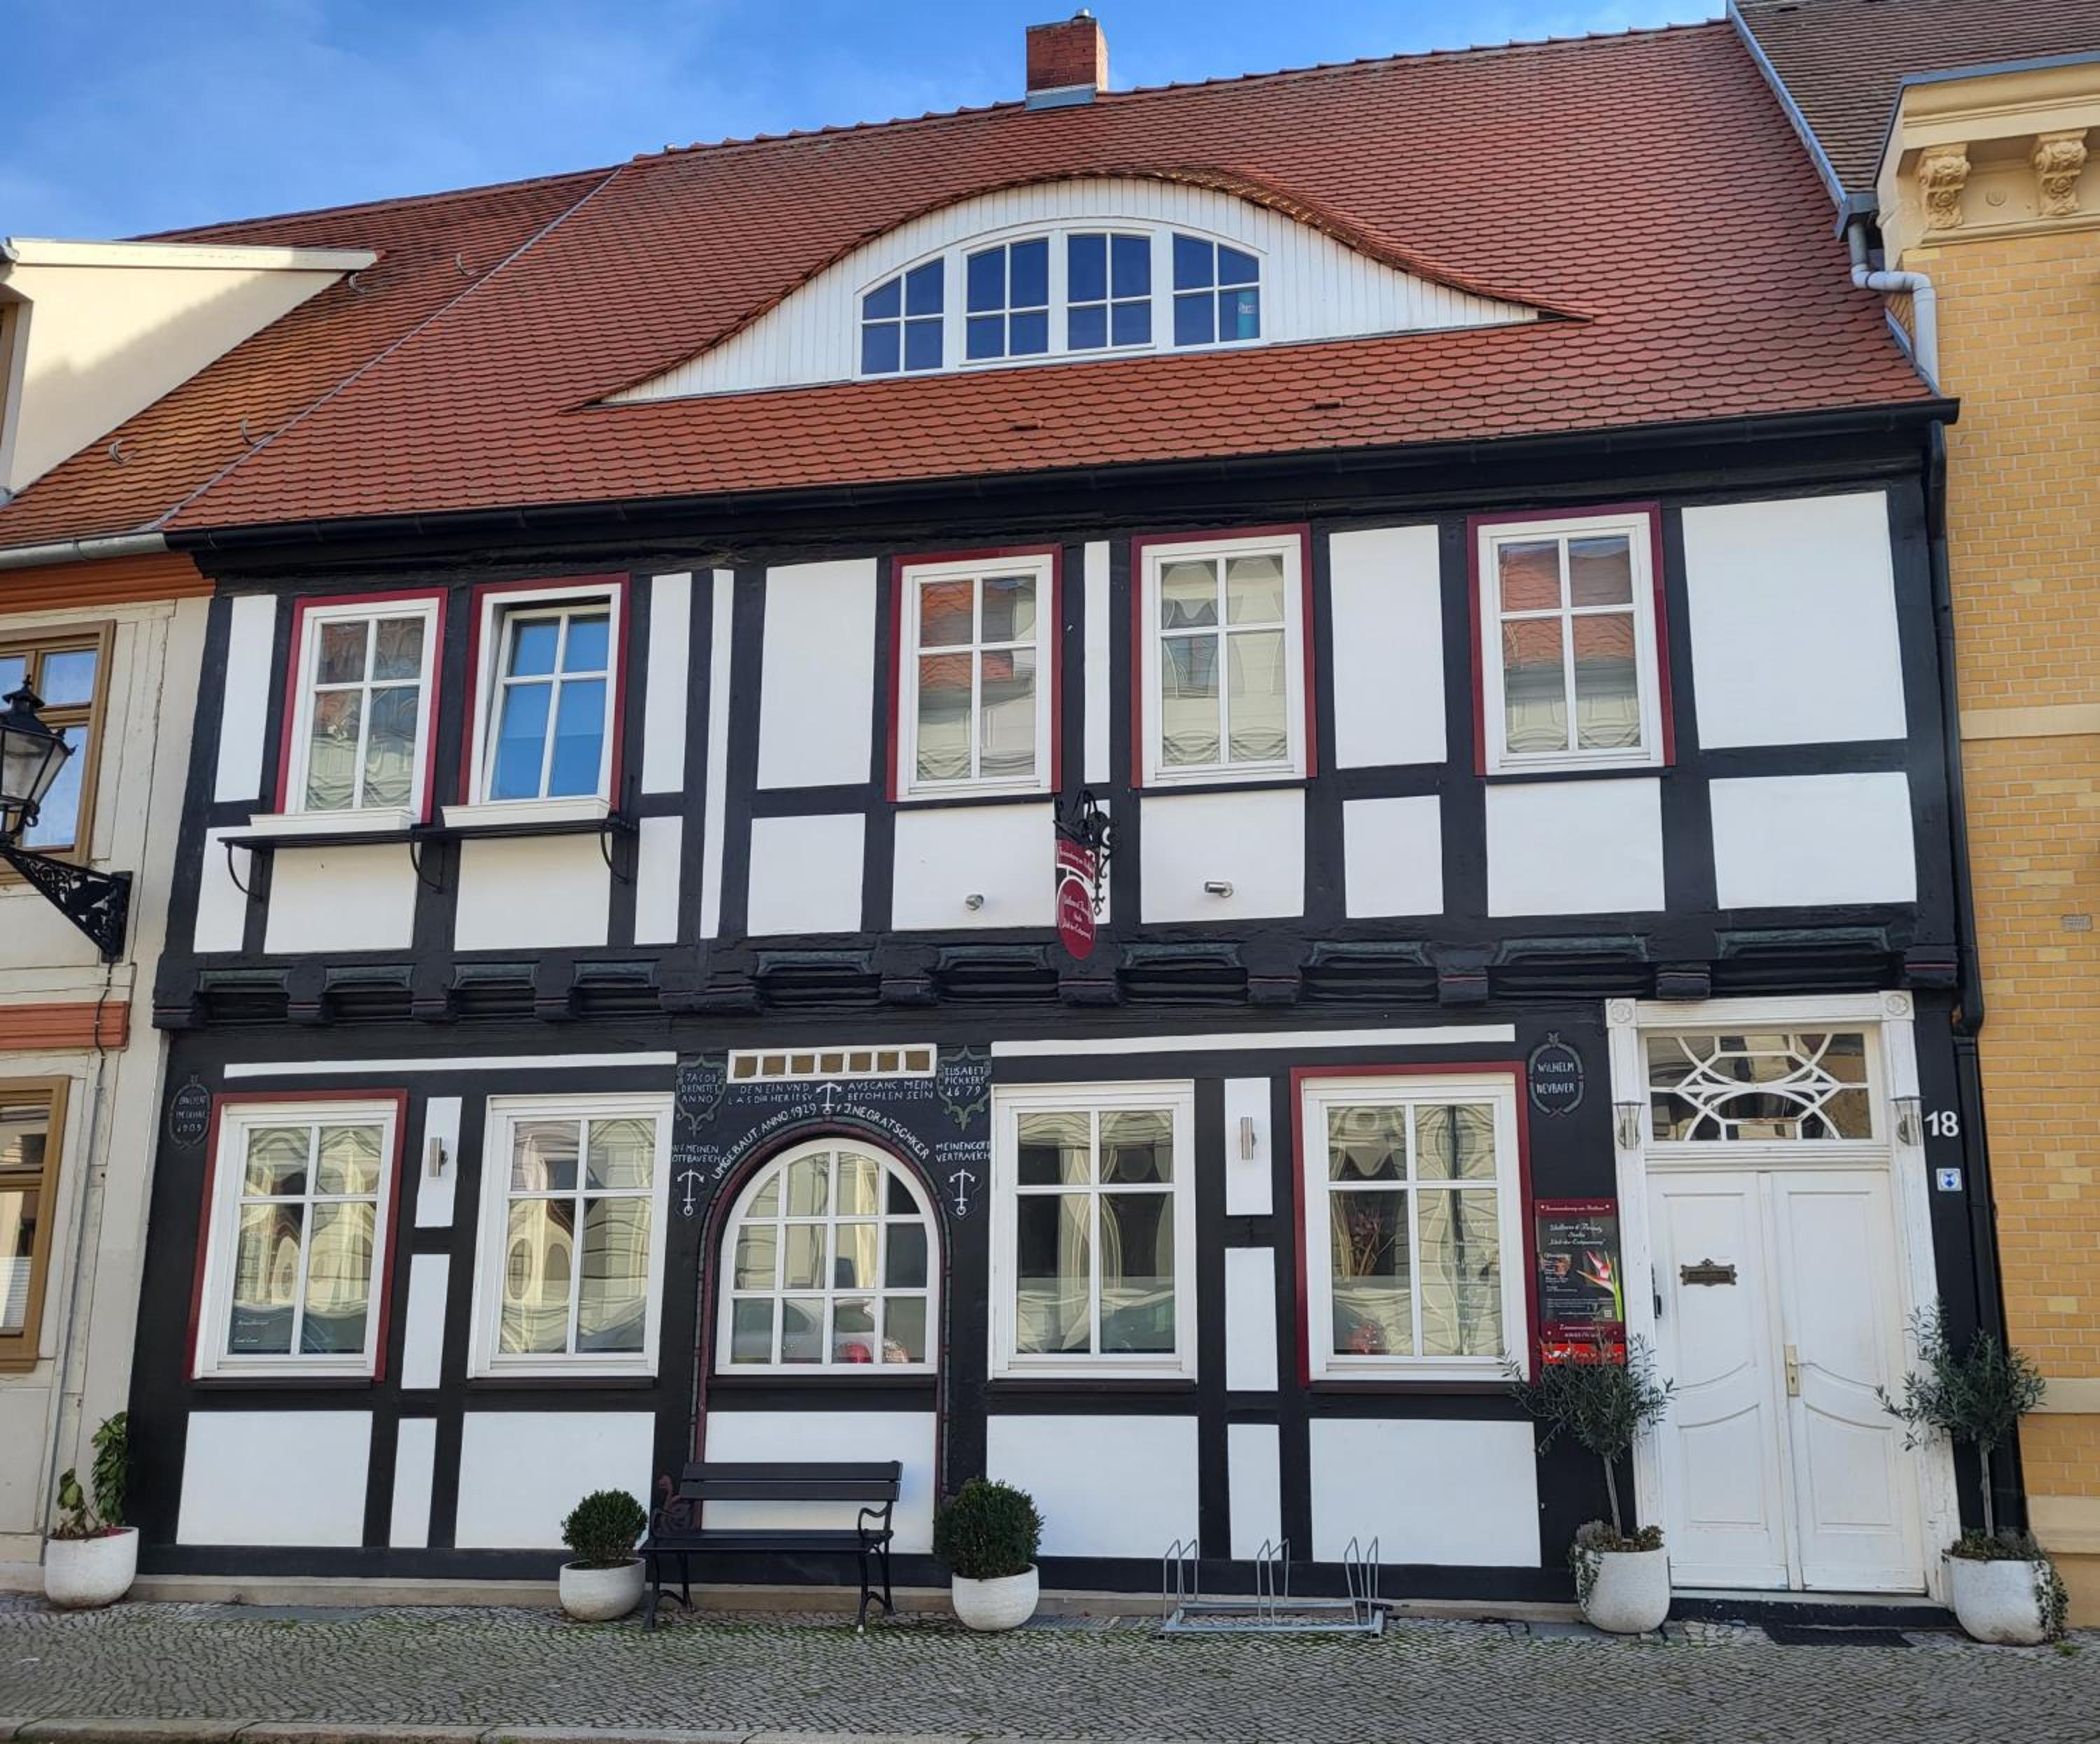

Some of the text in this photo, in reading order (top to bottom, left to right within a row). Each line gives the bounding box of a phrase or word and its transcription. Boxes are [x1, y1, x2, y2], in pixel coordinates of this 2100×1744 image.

[1537, 1062, 1574, 1073] WILHELM
[904, 1080, 933, 1090] MEIN
[682, 1095, 714, 1104] ANNO
[906, 1090, 933, 1099] SEIN
[1924, 1110, 1959, 1137] 18
